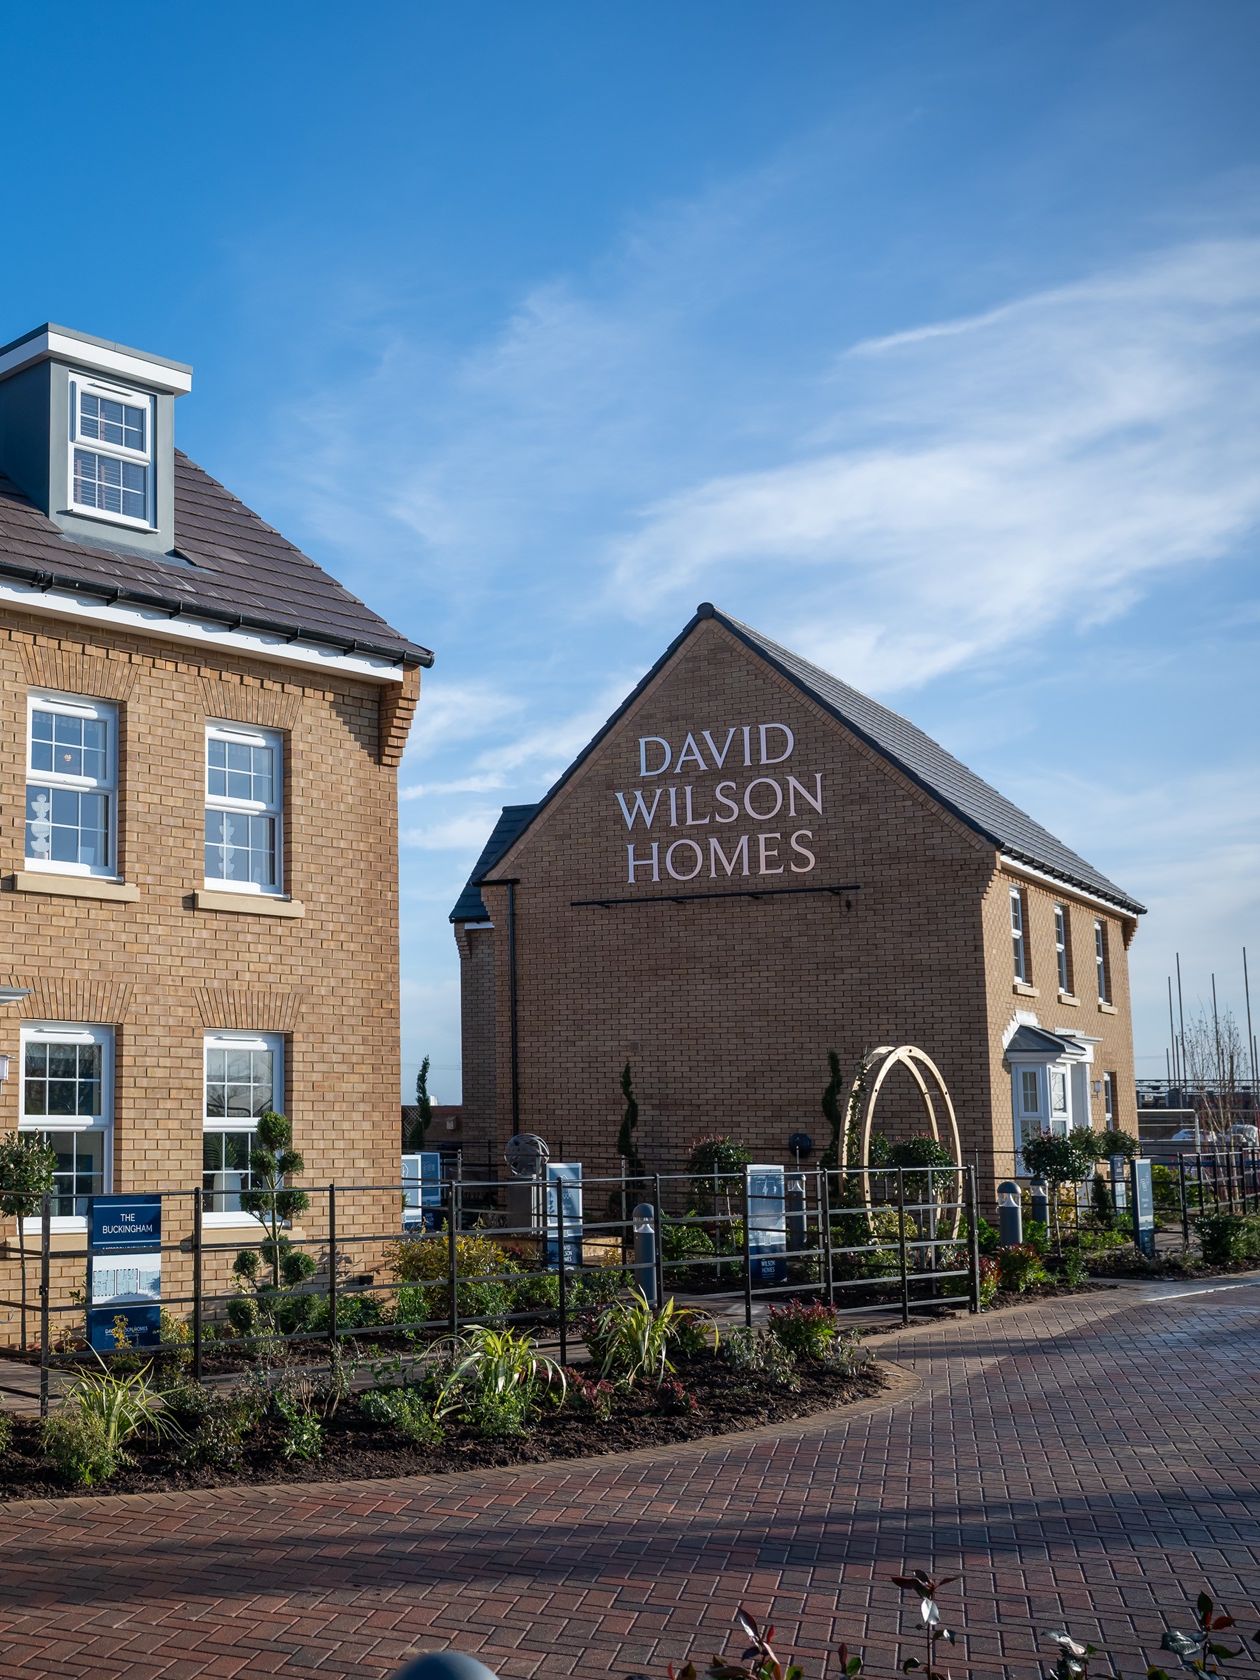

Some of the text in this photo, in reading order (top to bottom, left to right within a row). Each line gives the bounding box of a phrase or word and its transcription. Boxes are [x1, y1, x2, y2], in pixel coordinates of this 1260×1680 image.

[638, 723, 794, 777] DAVID
[614, 772, 823, 831] WILSON
[626, 830, 816, 884] HOMES
[102, 1224, 153, 1234] BUCKINGHAM
[120, 1213, 135, 1222] THE
